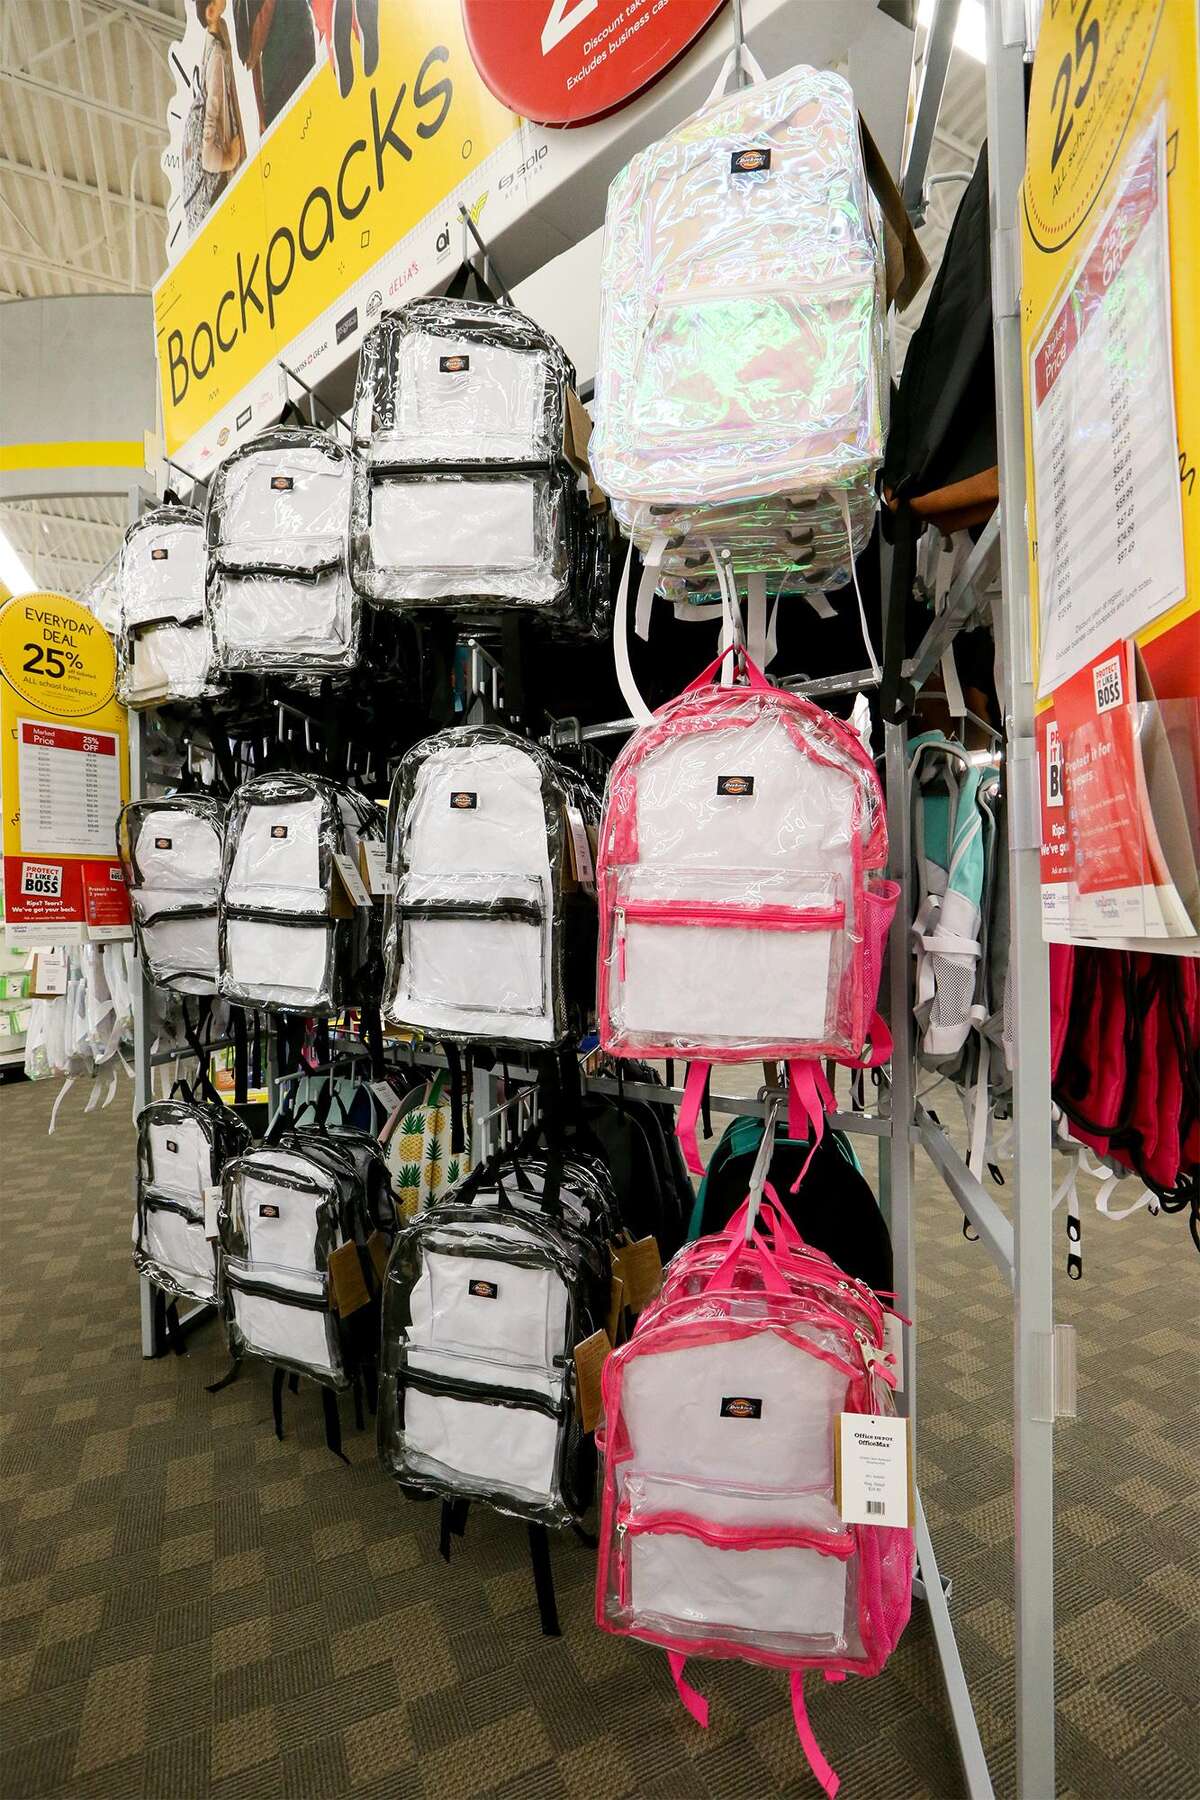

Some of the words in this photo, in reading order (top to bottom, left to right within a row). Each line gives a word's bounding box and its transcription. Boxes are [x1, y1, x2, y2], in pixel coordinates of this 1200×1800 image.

[583, 13, 624, 56] Discount
[566, 51, 607, 90] Excludes
[609, 13, 649, 53] business
[517, 145, 548, 177] solo
[168, 45, 453, 407] Backpacks
[436, 222, 450, 252] ai
[1045, 343, 1067, 387] Price
[25, 608, 94, 635] EVERYDAY
[43, 628, 78, 648] DEAL
[23, 643, 83, 678] 25%
[1096, 662, 1117, 680] PROTECT
[1102, 674, 1113, 686] LIKE
[1114, 672, 1118, 680] A
[24, 677, 37, 685] ALL
[40, 679, 61, 690] school
[63, 684, 97, 698] backpacks
[1097, 682, 1120, 707] BOSS
[33, 728, 55, 737] Marked
[33, 735, 55, 746] Price
[83, 736, 99, 745] 25%
[83, 743, 99, 752] OFF
[1098, 742, 1111, 756] for
[1052, 824, 1066, 838] Rips
[1041, 844, 1059, 856] We've
[26, 866, 59, 875] PROTECT
[25, 879, 58, 893] BOSS
[858, 1440, 890, 1448] OfficeMax
